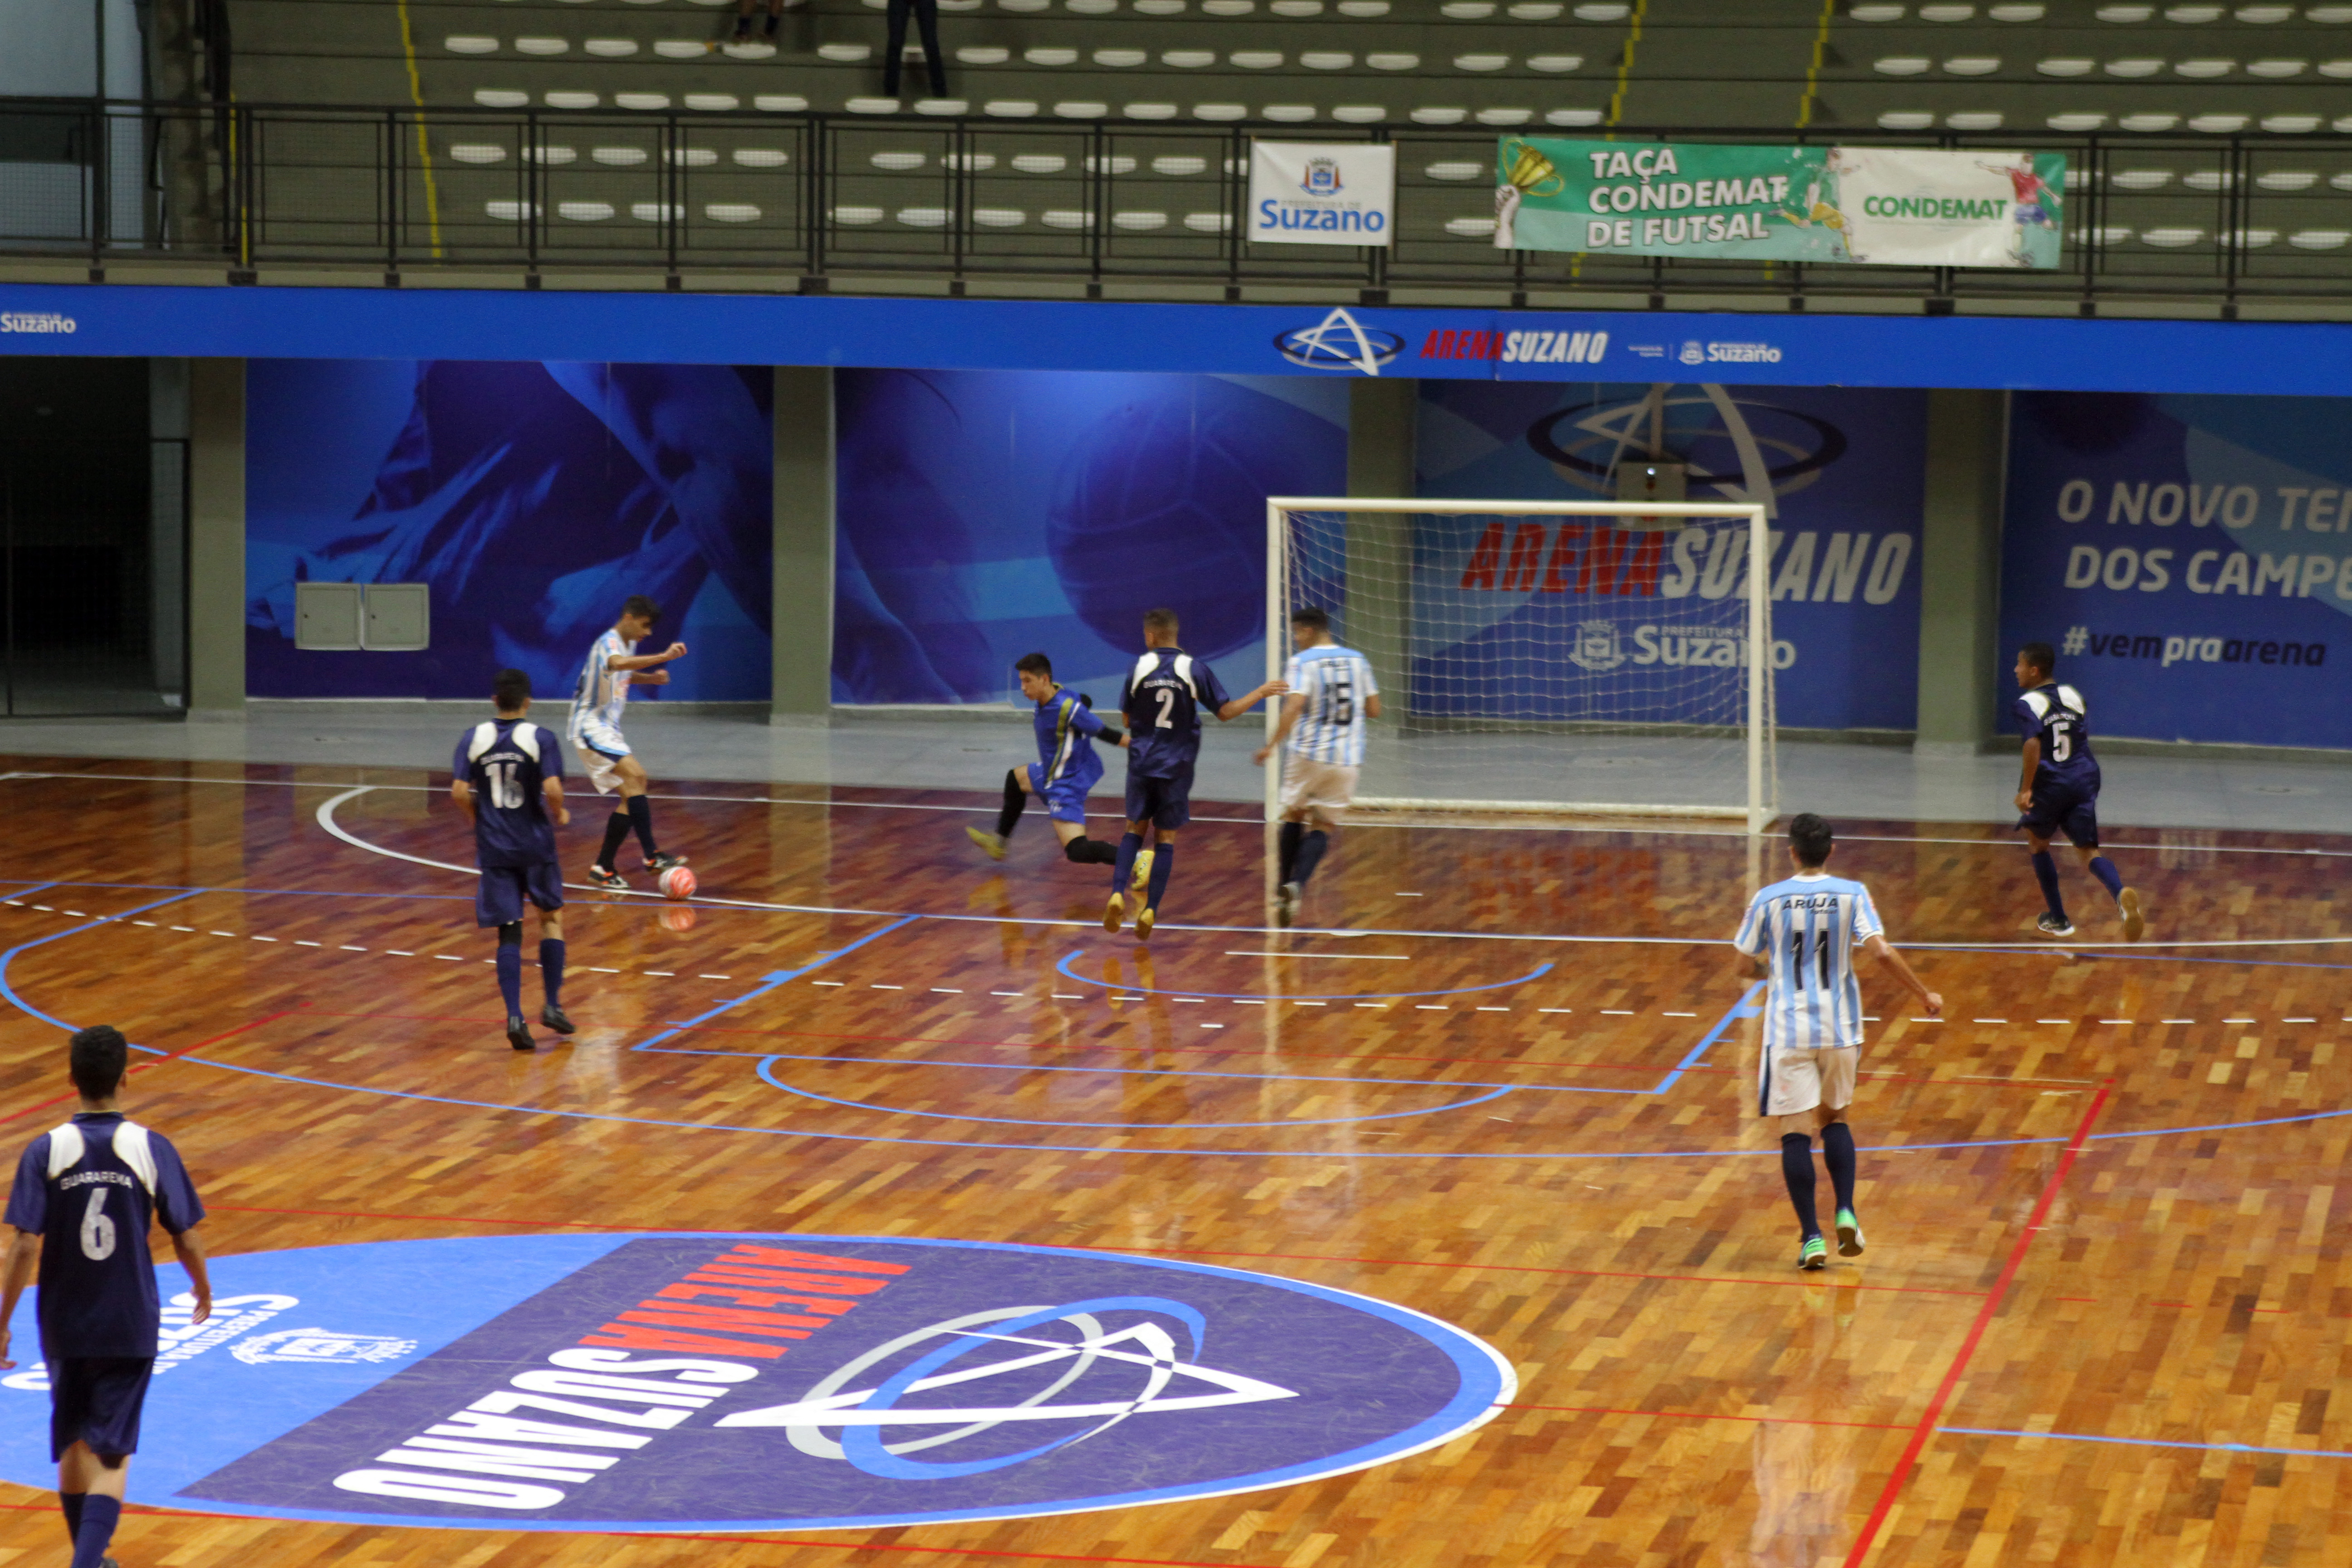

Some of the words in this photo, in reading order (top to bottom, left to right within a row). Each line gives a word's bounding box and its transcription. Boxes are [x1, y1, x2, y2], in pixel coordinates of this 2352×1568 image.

[1589, 148, 1678, 183] TAÇA
[1589, 176, 1788, 214] CONDEMAT
[1863, 196, 2007, 220] CONDEMAT
[1259, 199, 1385, 233] Suzano
[1588, 220, 1632, 248] DE
[1643, 212, 1769, 245] FUTSAL
[0, 313, 77, 333] Suzano
[1707, 343, 1781, 363] Suzano
[2057, 480, 2094, 523] O
[2107, 483, 2259, 528] NOVO
[2064, 546, 2174, 592] DOS
[1155, 688, 1174, 729] 2
[2052, 722, 2071, 762] 5
[485, 764, 524, 809] 16
[1790, 929, 1831, 992] 11
[80, 1187, 116, 1261] 6
